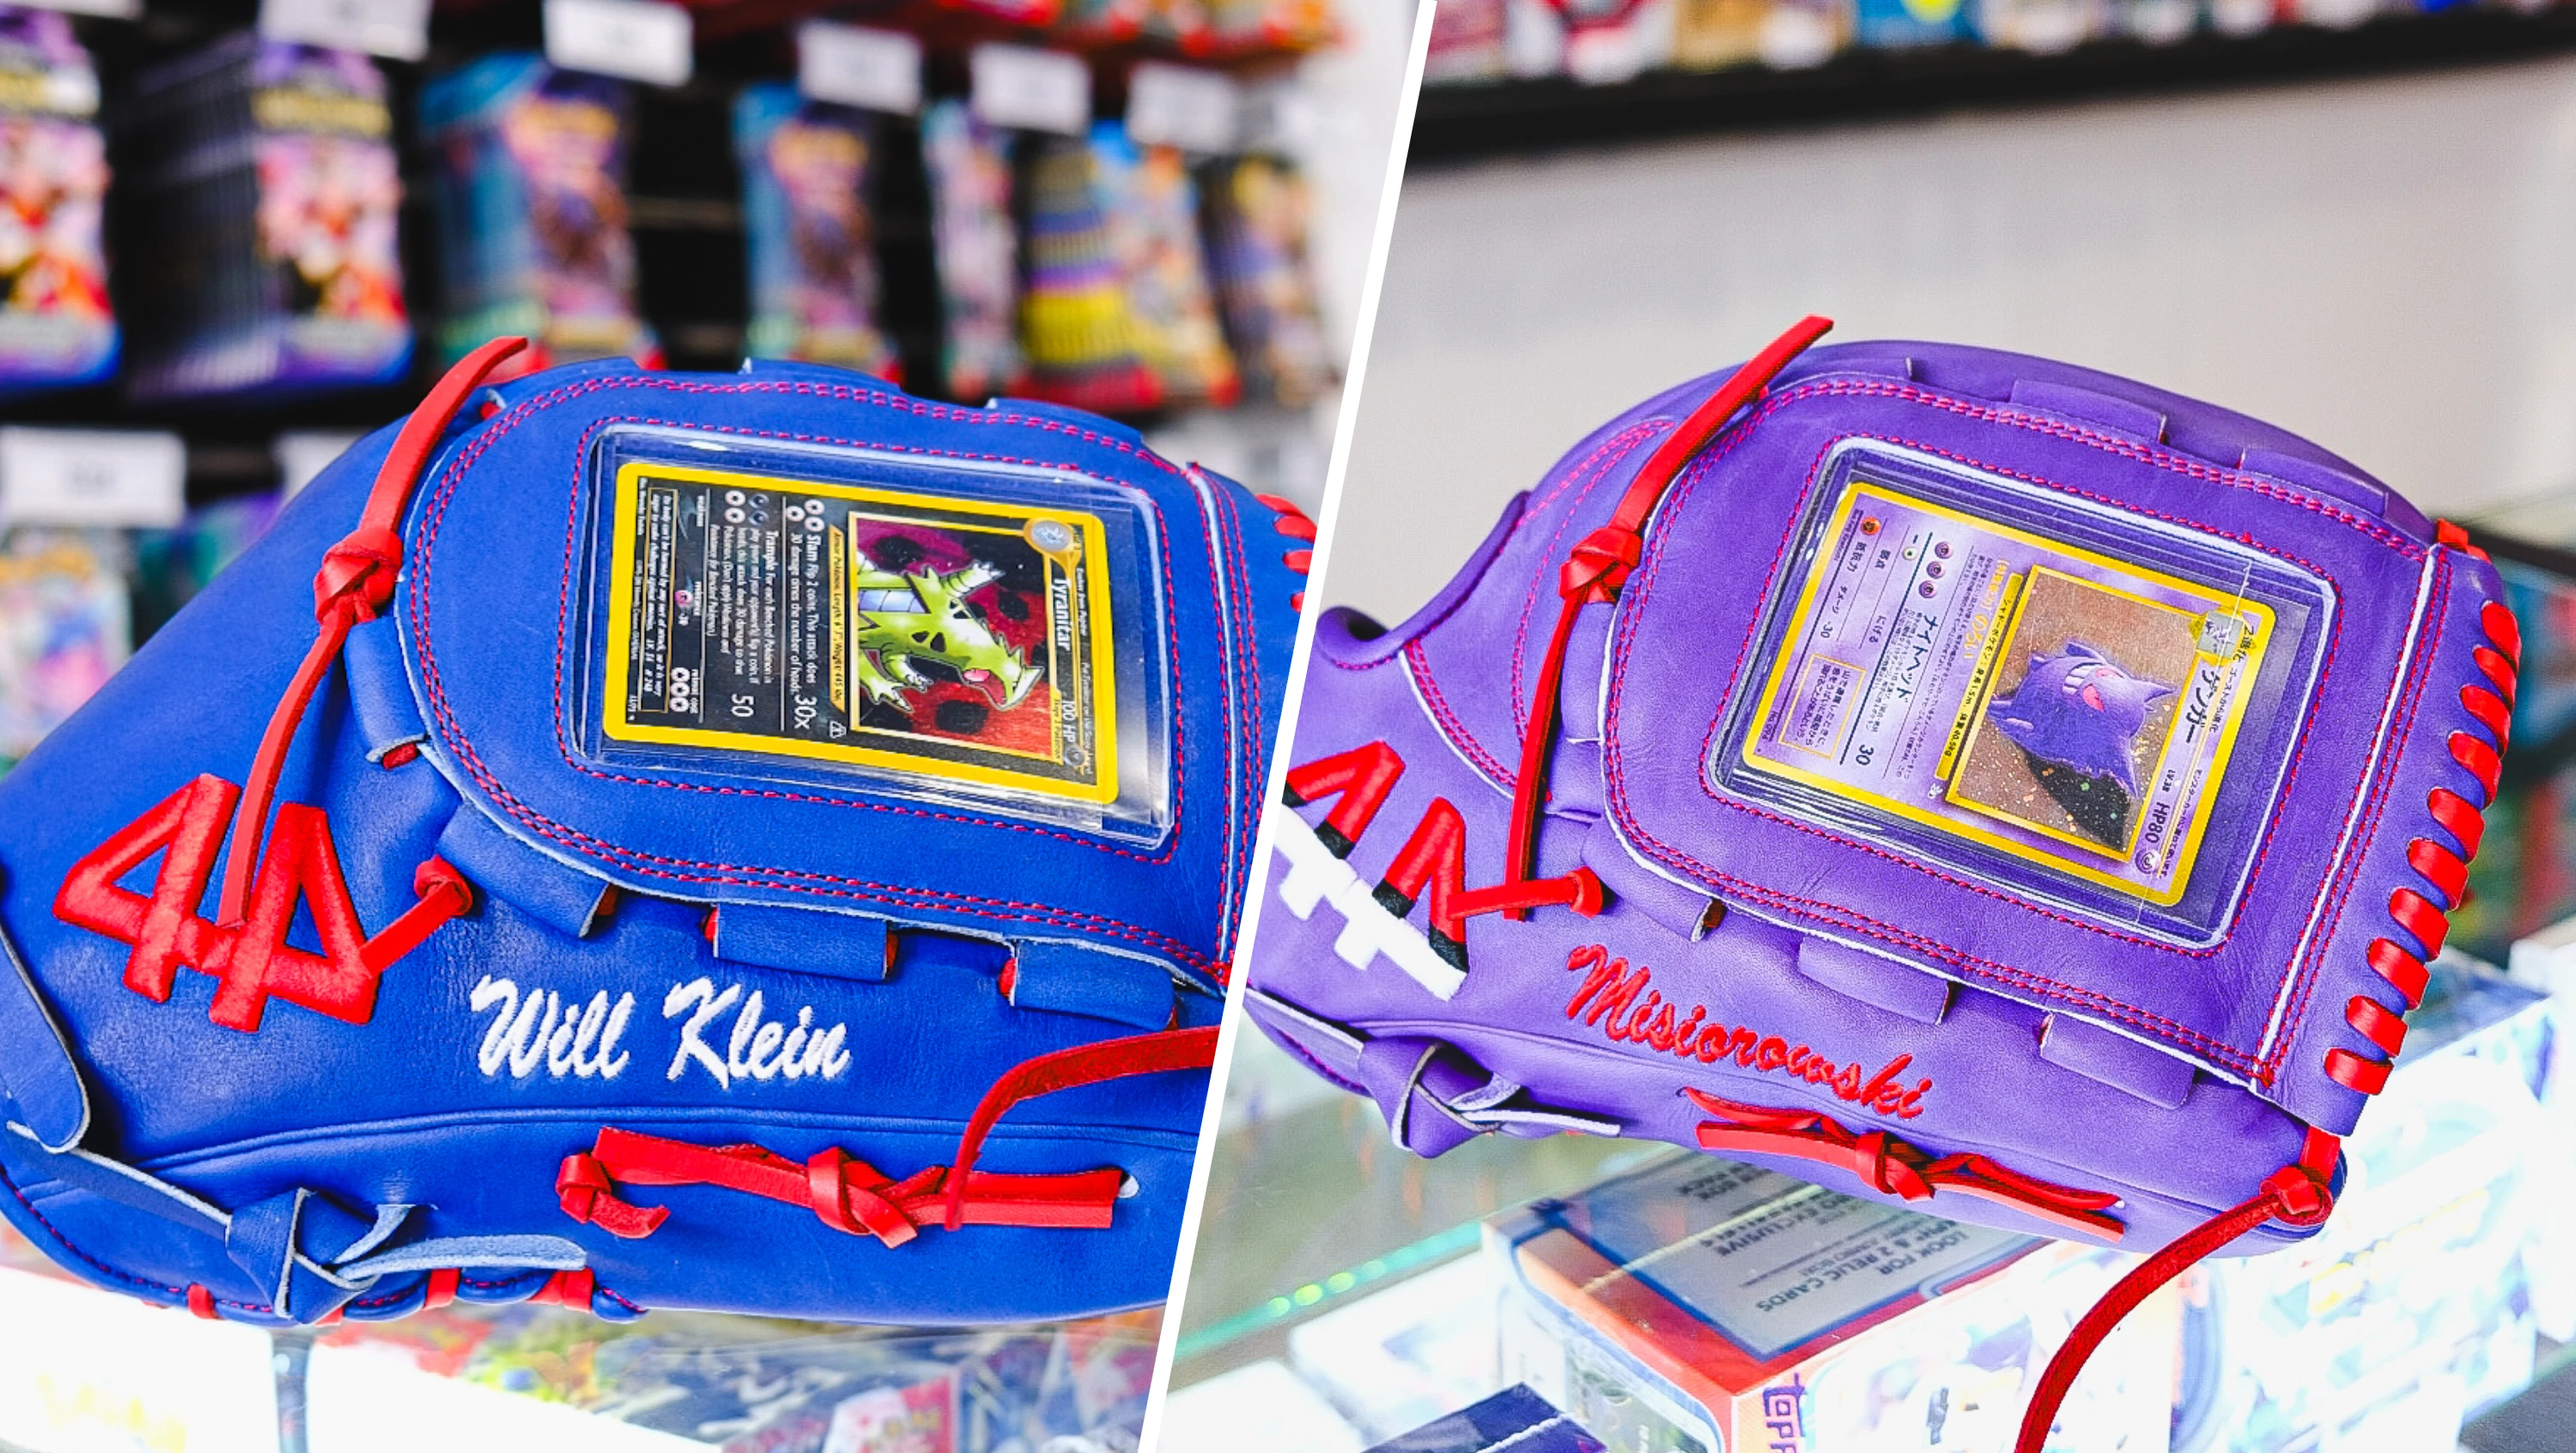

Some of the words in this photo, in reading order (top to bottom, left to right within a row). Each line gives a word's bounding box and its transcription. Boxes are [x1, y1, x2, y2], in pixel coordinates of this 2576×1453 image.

[761, 529, 779, 571] Trample
[805, 533, 822, 562] Slam
[790, 602, 802, 618] the
[806, 613, 818, 632] This
[1050, 576, 1073, 651] Tyranitar
[790, 619, 802, 653] number
[1819, 620, 1833, 639] -30
[1868, 614, 1886, 643] にげる
[789, 654, 802, 666] of
[805, 661, 817, 684] does
[1896, 614, 1938, 702] ナイトヘッド
[730, 692, 754, 719] 50
[793, 693, 817, 731] 30x
[1060, 699, 1075, 721] 100
[2184, 669, 2221, 743] ゲンガー
[1061, 723, 1076, 743] HP
[1855, 744, 1874, 766] 30
[2143, 801, 2170, 843] HP80
[470, 974, 636, 1079] Will
[662, 976, 851, 1091] Klein
[1564, 943, 1933, 1120] Misiorowski
[1920, 1231, 1969, 1257] LOOK
[1823, 1254, 1880, 1283] RELIC
[1880, 1255, 1917, 1277] FOR
[1755, 1277, 1825, 1313] CARDS
